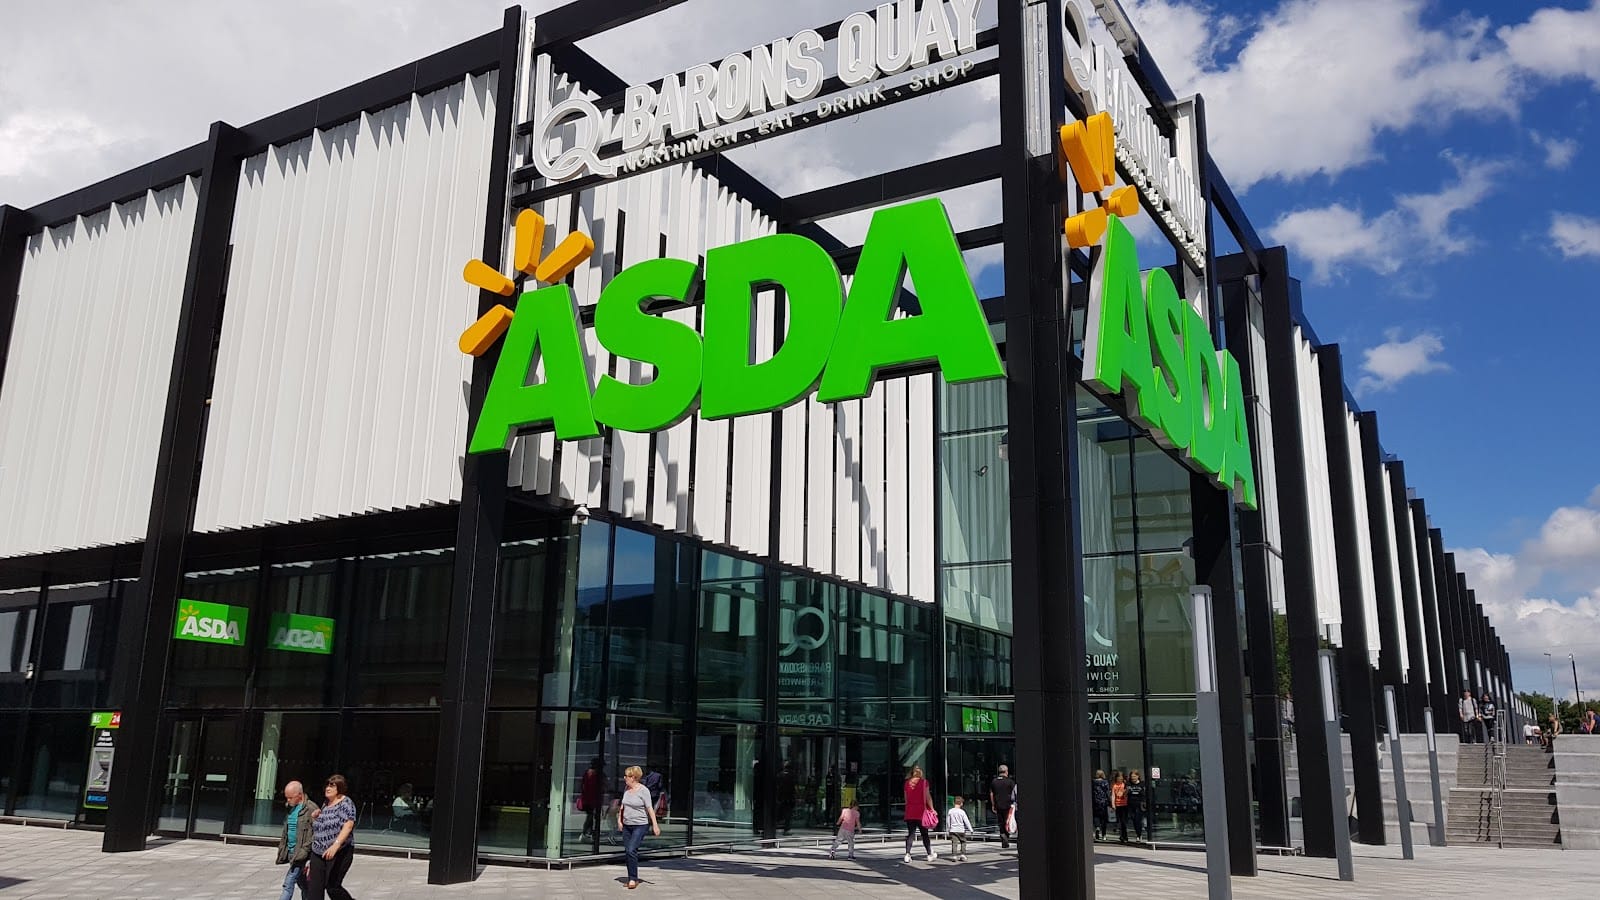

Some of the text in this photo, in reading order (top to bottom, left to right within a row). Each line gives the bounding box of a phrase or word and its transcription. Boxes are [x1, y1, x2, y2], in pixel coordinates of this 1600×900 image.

[622, 28, 825, 152] BARONS
[838, 0, 985, 86] QUAY
[623, 58, 975, 173] NORTHWICH EAT DRINK SHOP
[469, 198, 1008, 455] ASDA
[1084, 213, 1258, 512] ASDA
[181, 615, 240, 641] ASDA
[1093, 654, 1118, 667] QUAY
[1087, 712, 1121, 725] PARK
